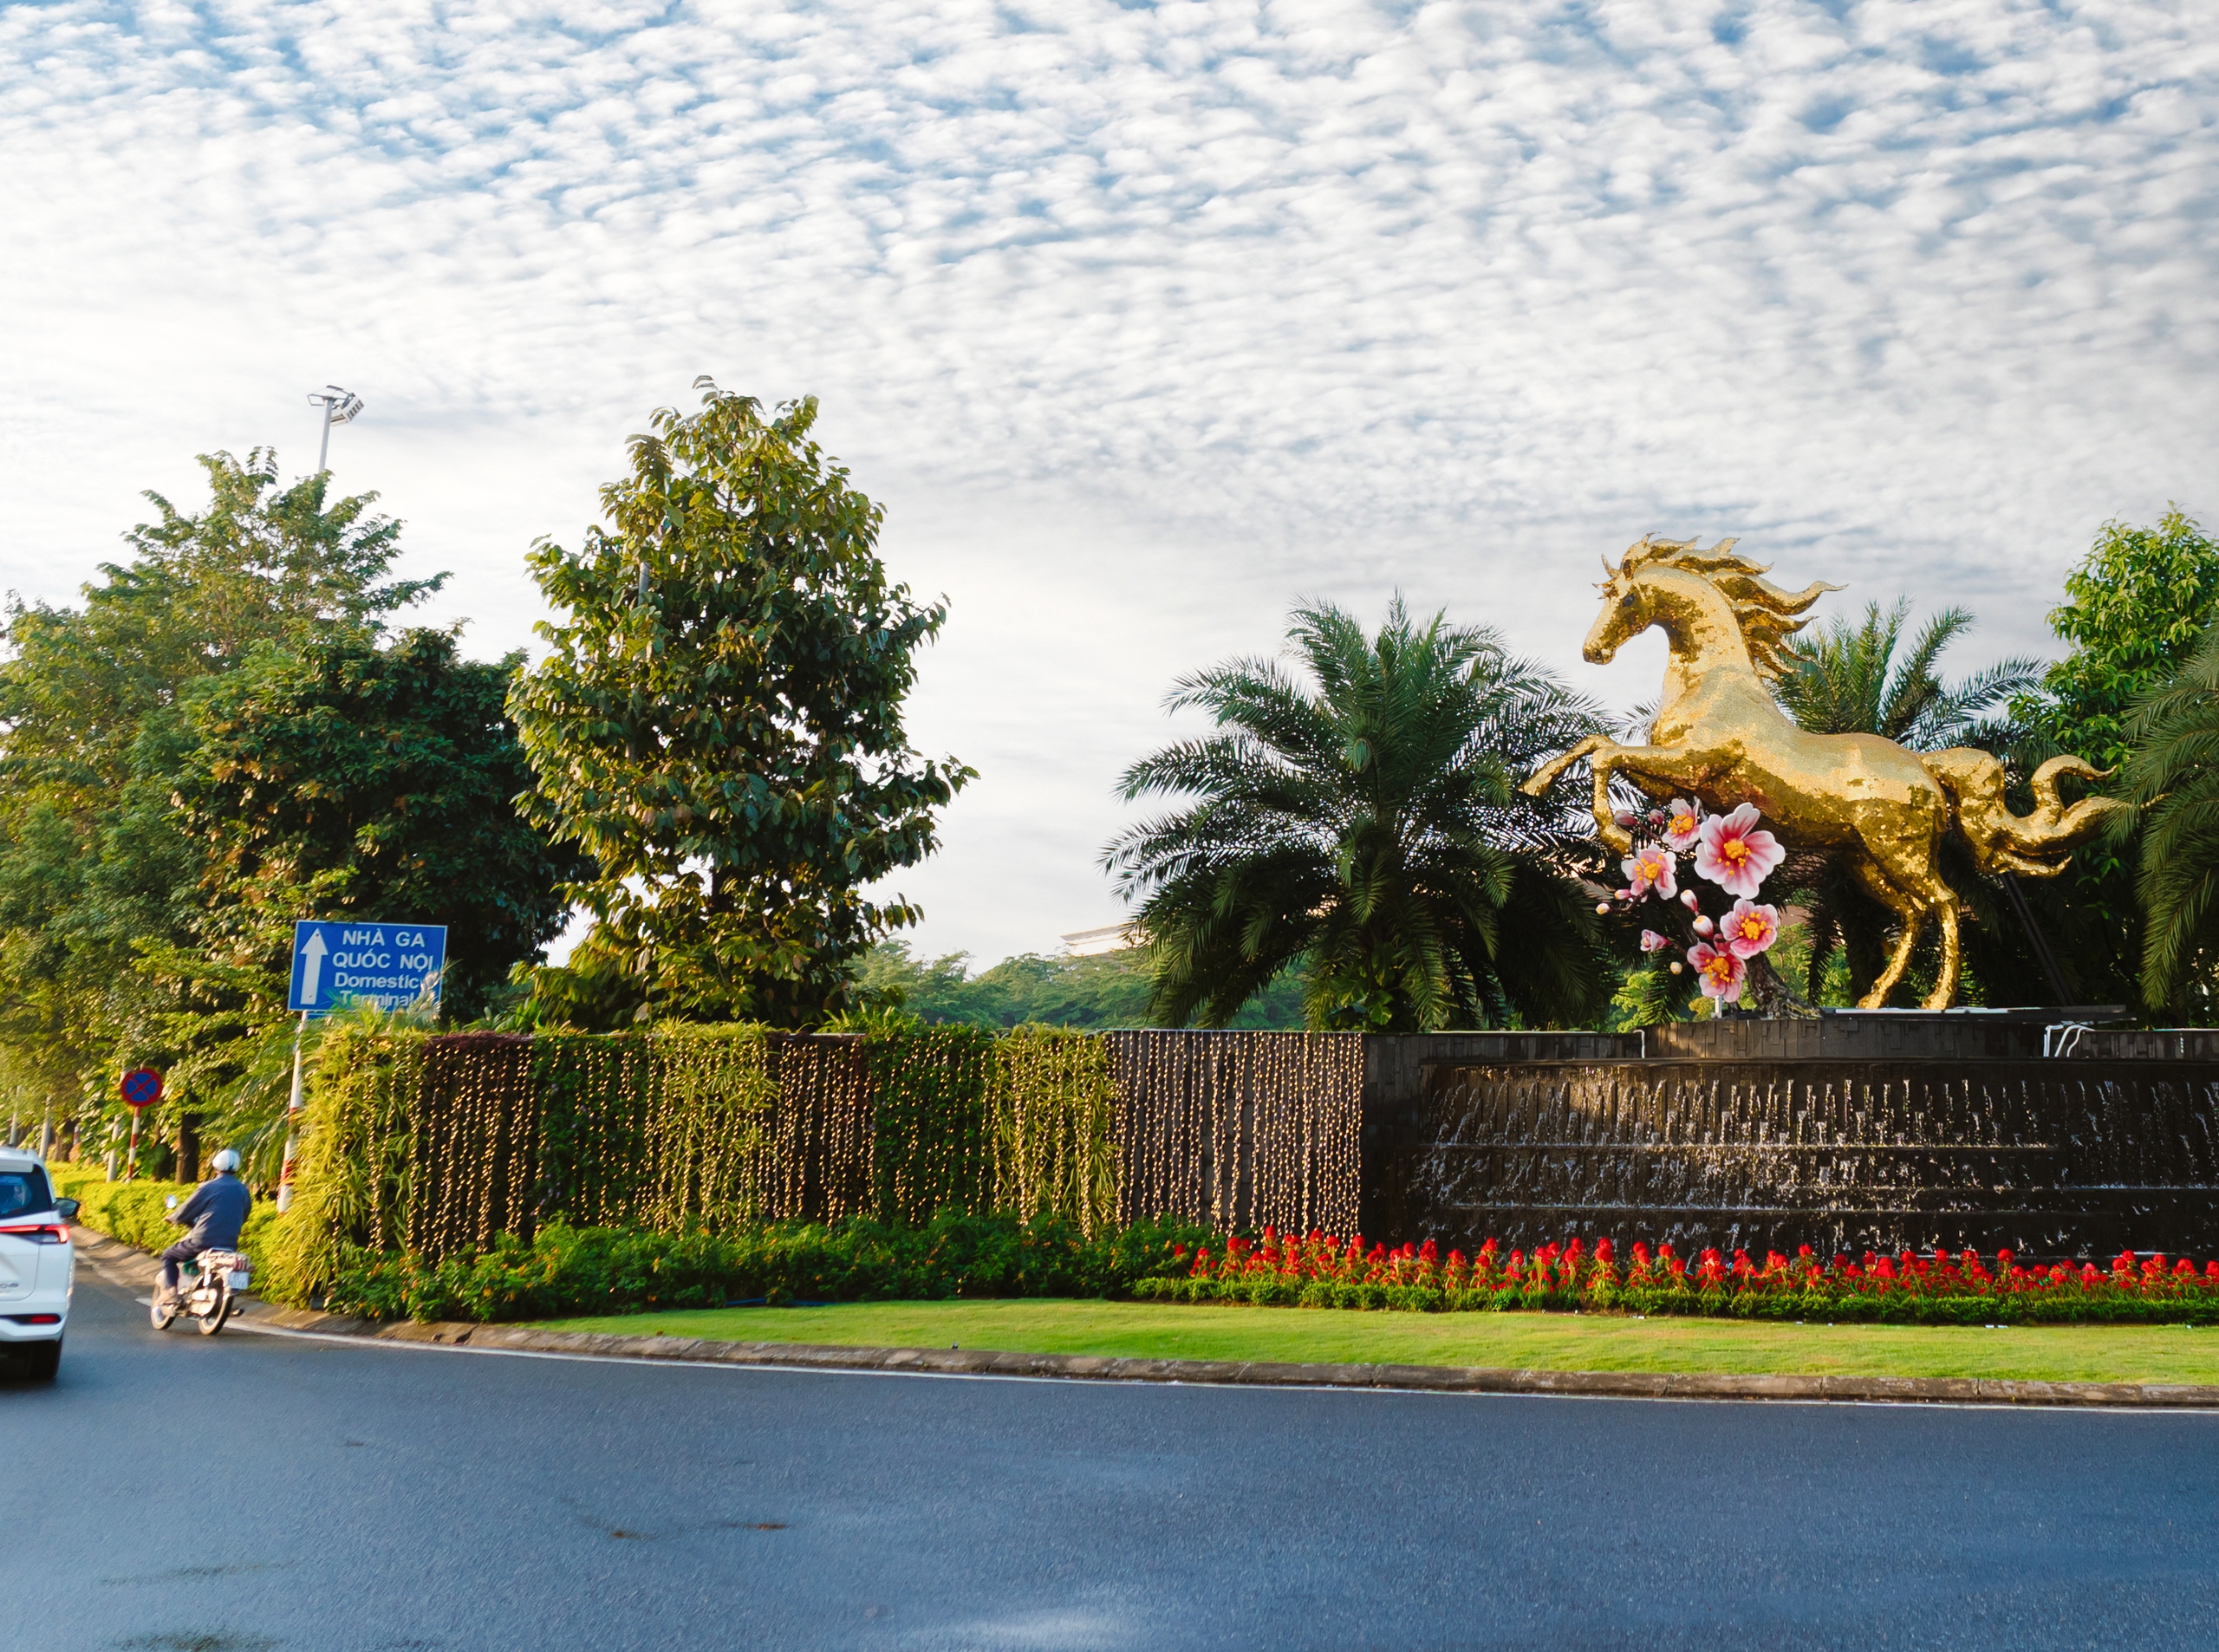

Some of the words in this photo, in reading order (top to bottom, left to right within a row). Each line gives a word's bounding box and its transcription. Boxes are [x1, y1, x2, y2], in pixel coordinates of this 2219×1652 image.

[342, 927, 385, 946] NHÀ
[395, 932, 425, 947] GA
[332, 948, 391, 969] QUỐC
[400, 953, 433, 972] NỘI
[334, 972, 420, 990] Domestic
